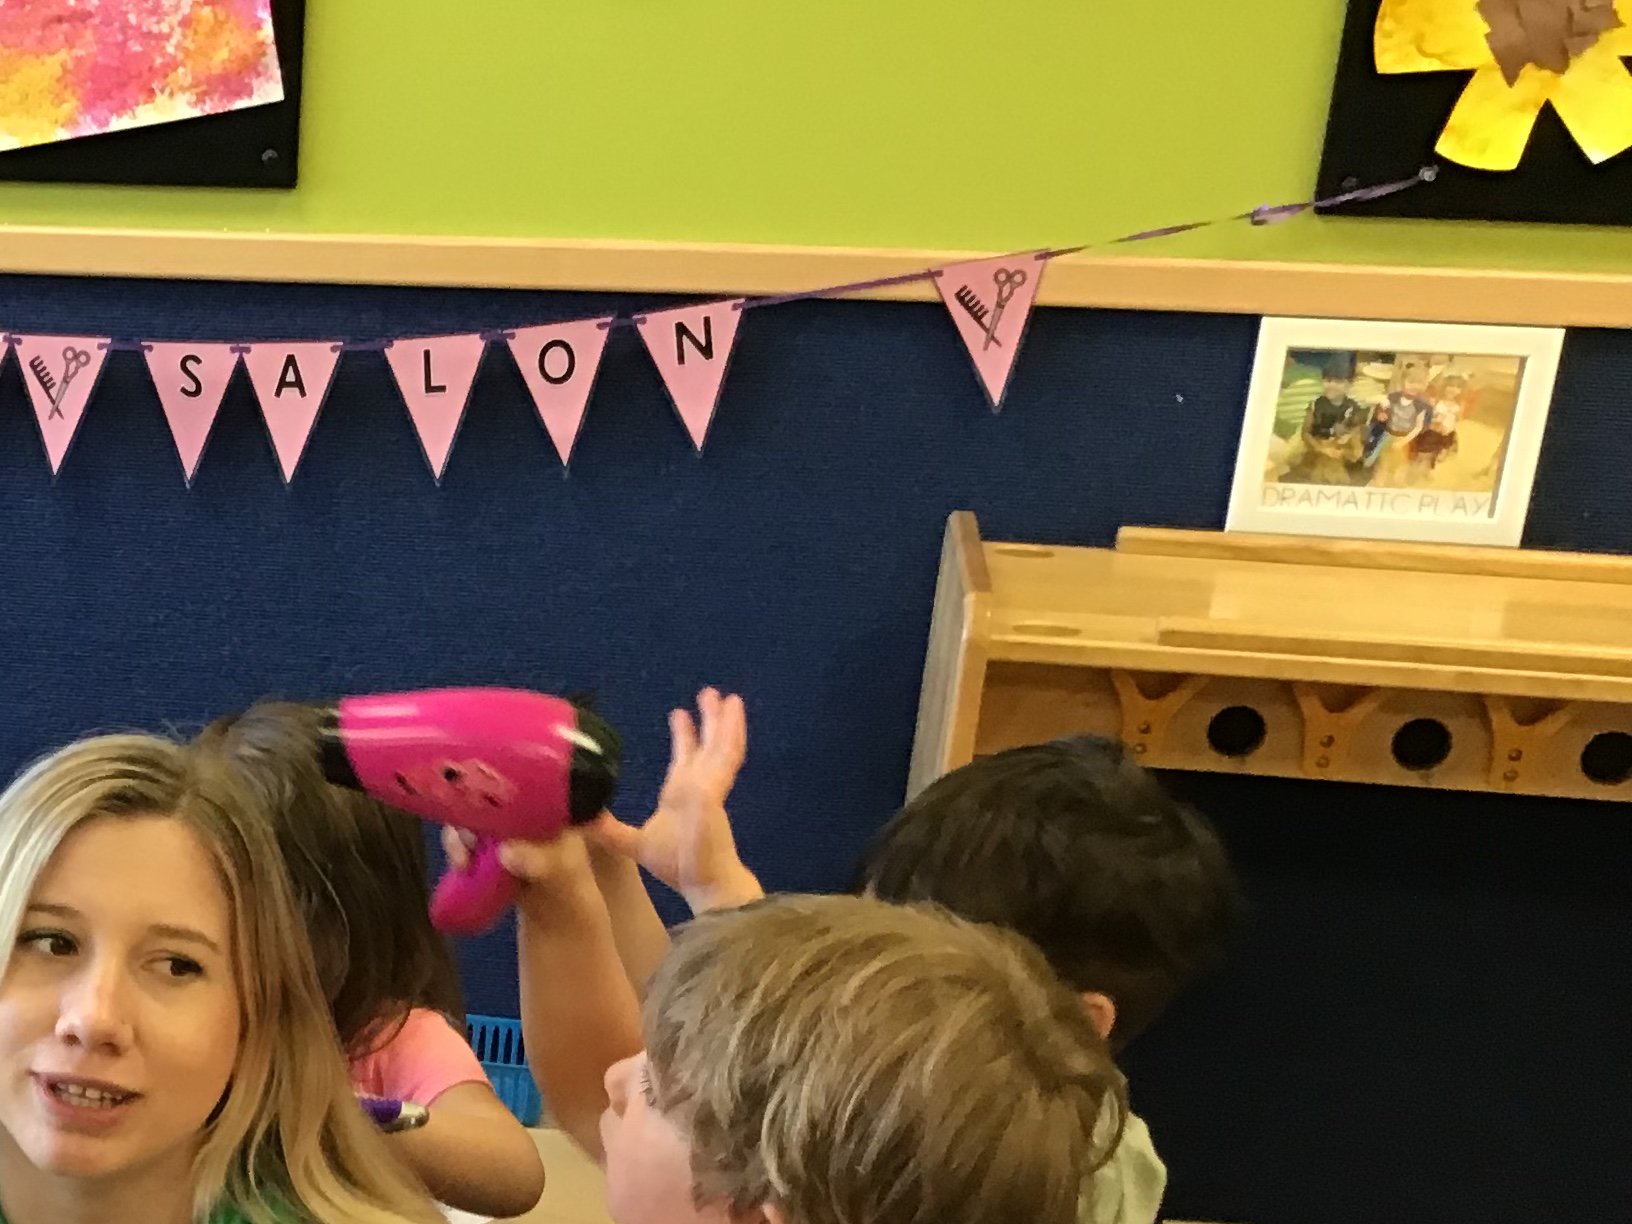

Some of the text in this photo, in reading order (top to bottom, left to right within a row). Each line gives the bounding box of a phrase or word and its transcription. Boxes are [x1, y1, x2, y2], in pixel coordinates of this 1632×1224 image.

[178, 314, 714, 400] SALON
[1262, 486, 1490, 518] DRAMATIC PLAY
